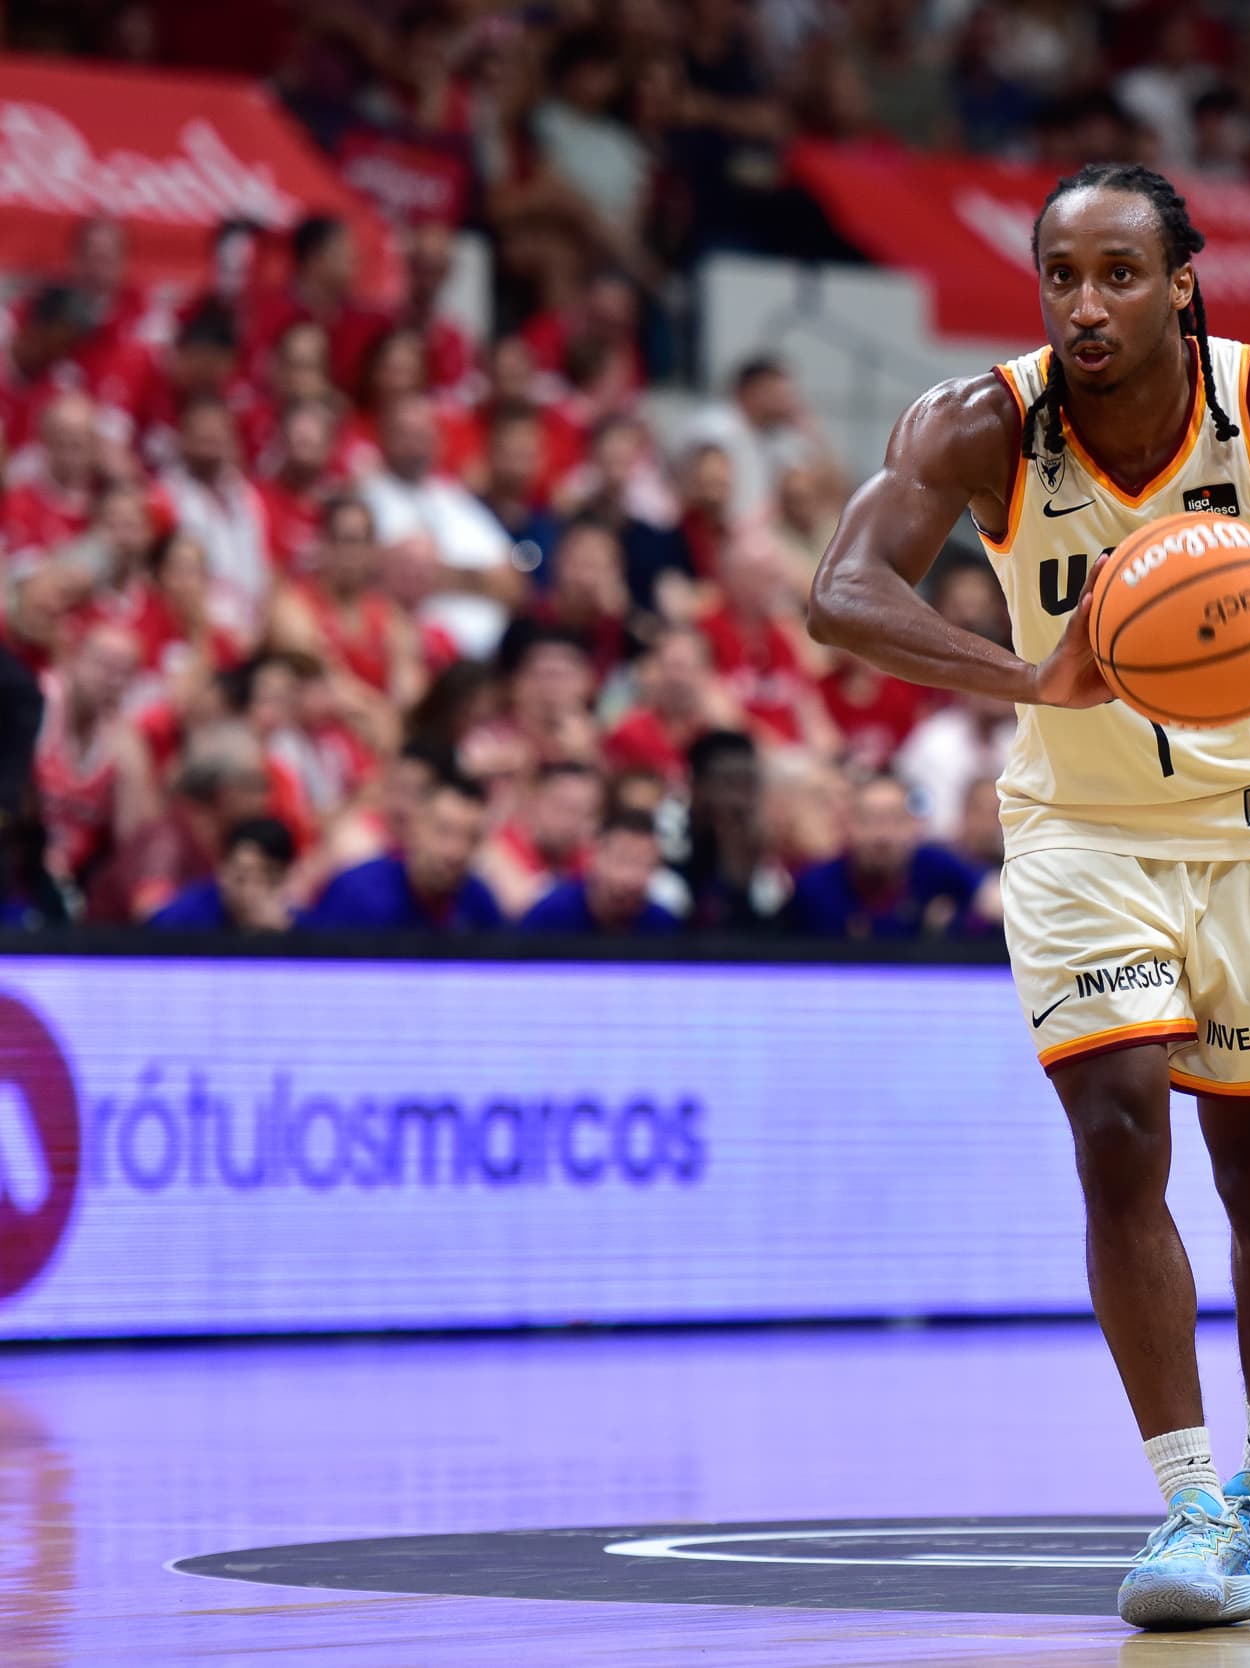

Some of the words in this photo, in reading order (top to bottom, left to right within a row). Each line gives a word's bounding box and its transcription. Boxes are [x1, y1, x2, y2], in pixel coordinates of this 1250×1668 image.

[1188, 499, 1210, 511] liga
[1197, 505, 1237, 515] desa
[1075, 955, 1175, 998] INVERSUS
